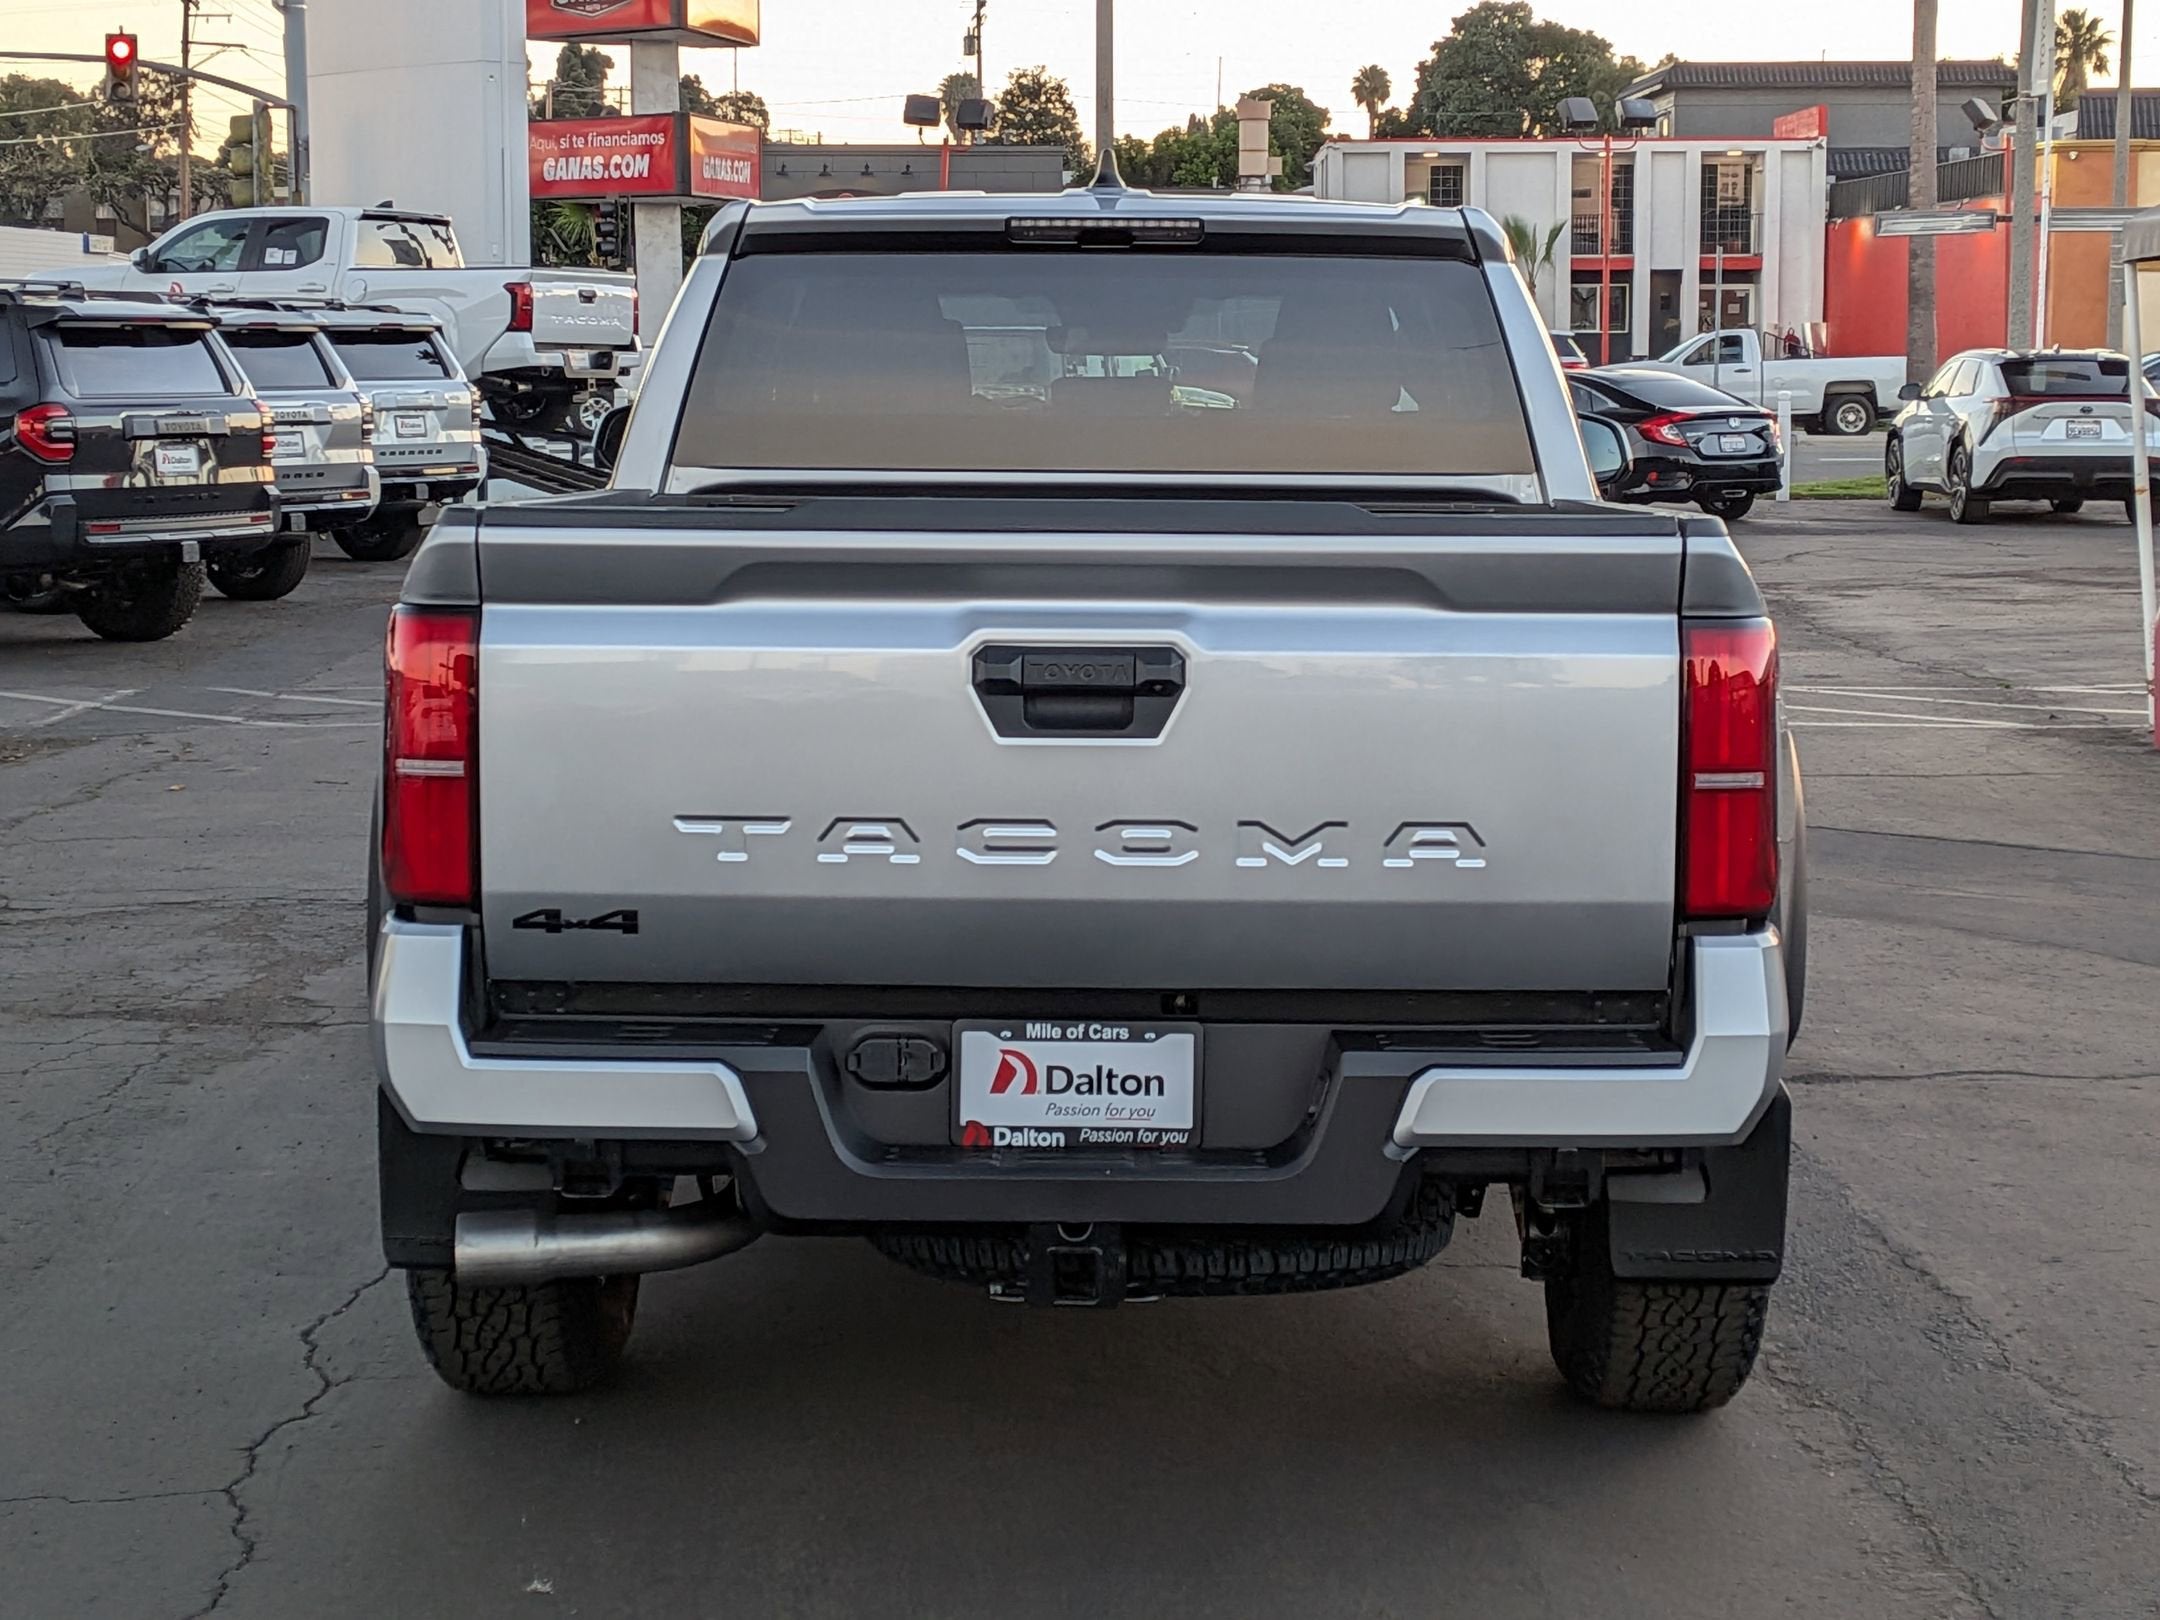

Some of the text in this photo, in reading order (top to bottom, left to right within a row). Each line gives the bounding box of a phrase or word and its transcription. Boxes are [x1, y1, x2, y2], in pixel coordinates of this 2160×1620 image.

[572, 135, 585, 148] te
[587, 130, 665, 147] financiamos
[543, 154, 649, 181] GANAS.COM
[703, 155, 751, 184] GANAS.COM
[550, 315, 621, 325] TACOMA
[275, 410, 308, 419] TOYOTA
[164, 421, 204, 431] TOYOTA
[1029, 663, 1129, 681] TOYOTA
[672, 815, 1486, 867] TACOMA
[512, 908, 639, 934] 4x4
[1025, 1023, 1129, 1040] Mile of Cars
[1045, 1065, 1165, 1096] Dalton
[1045, 1103, 1156, 1119] Passion for you
[993, 1127, 1065, 1147] Dalton
[1079, 1128, 1189, 1146] Passion for you
